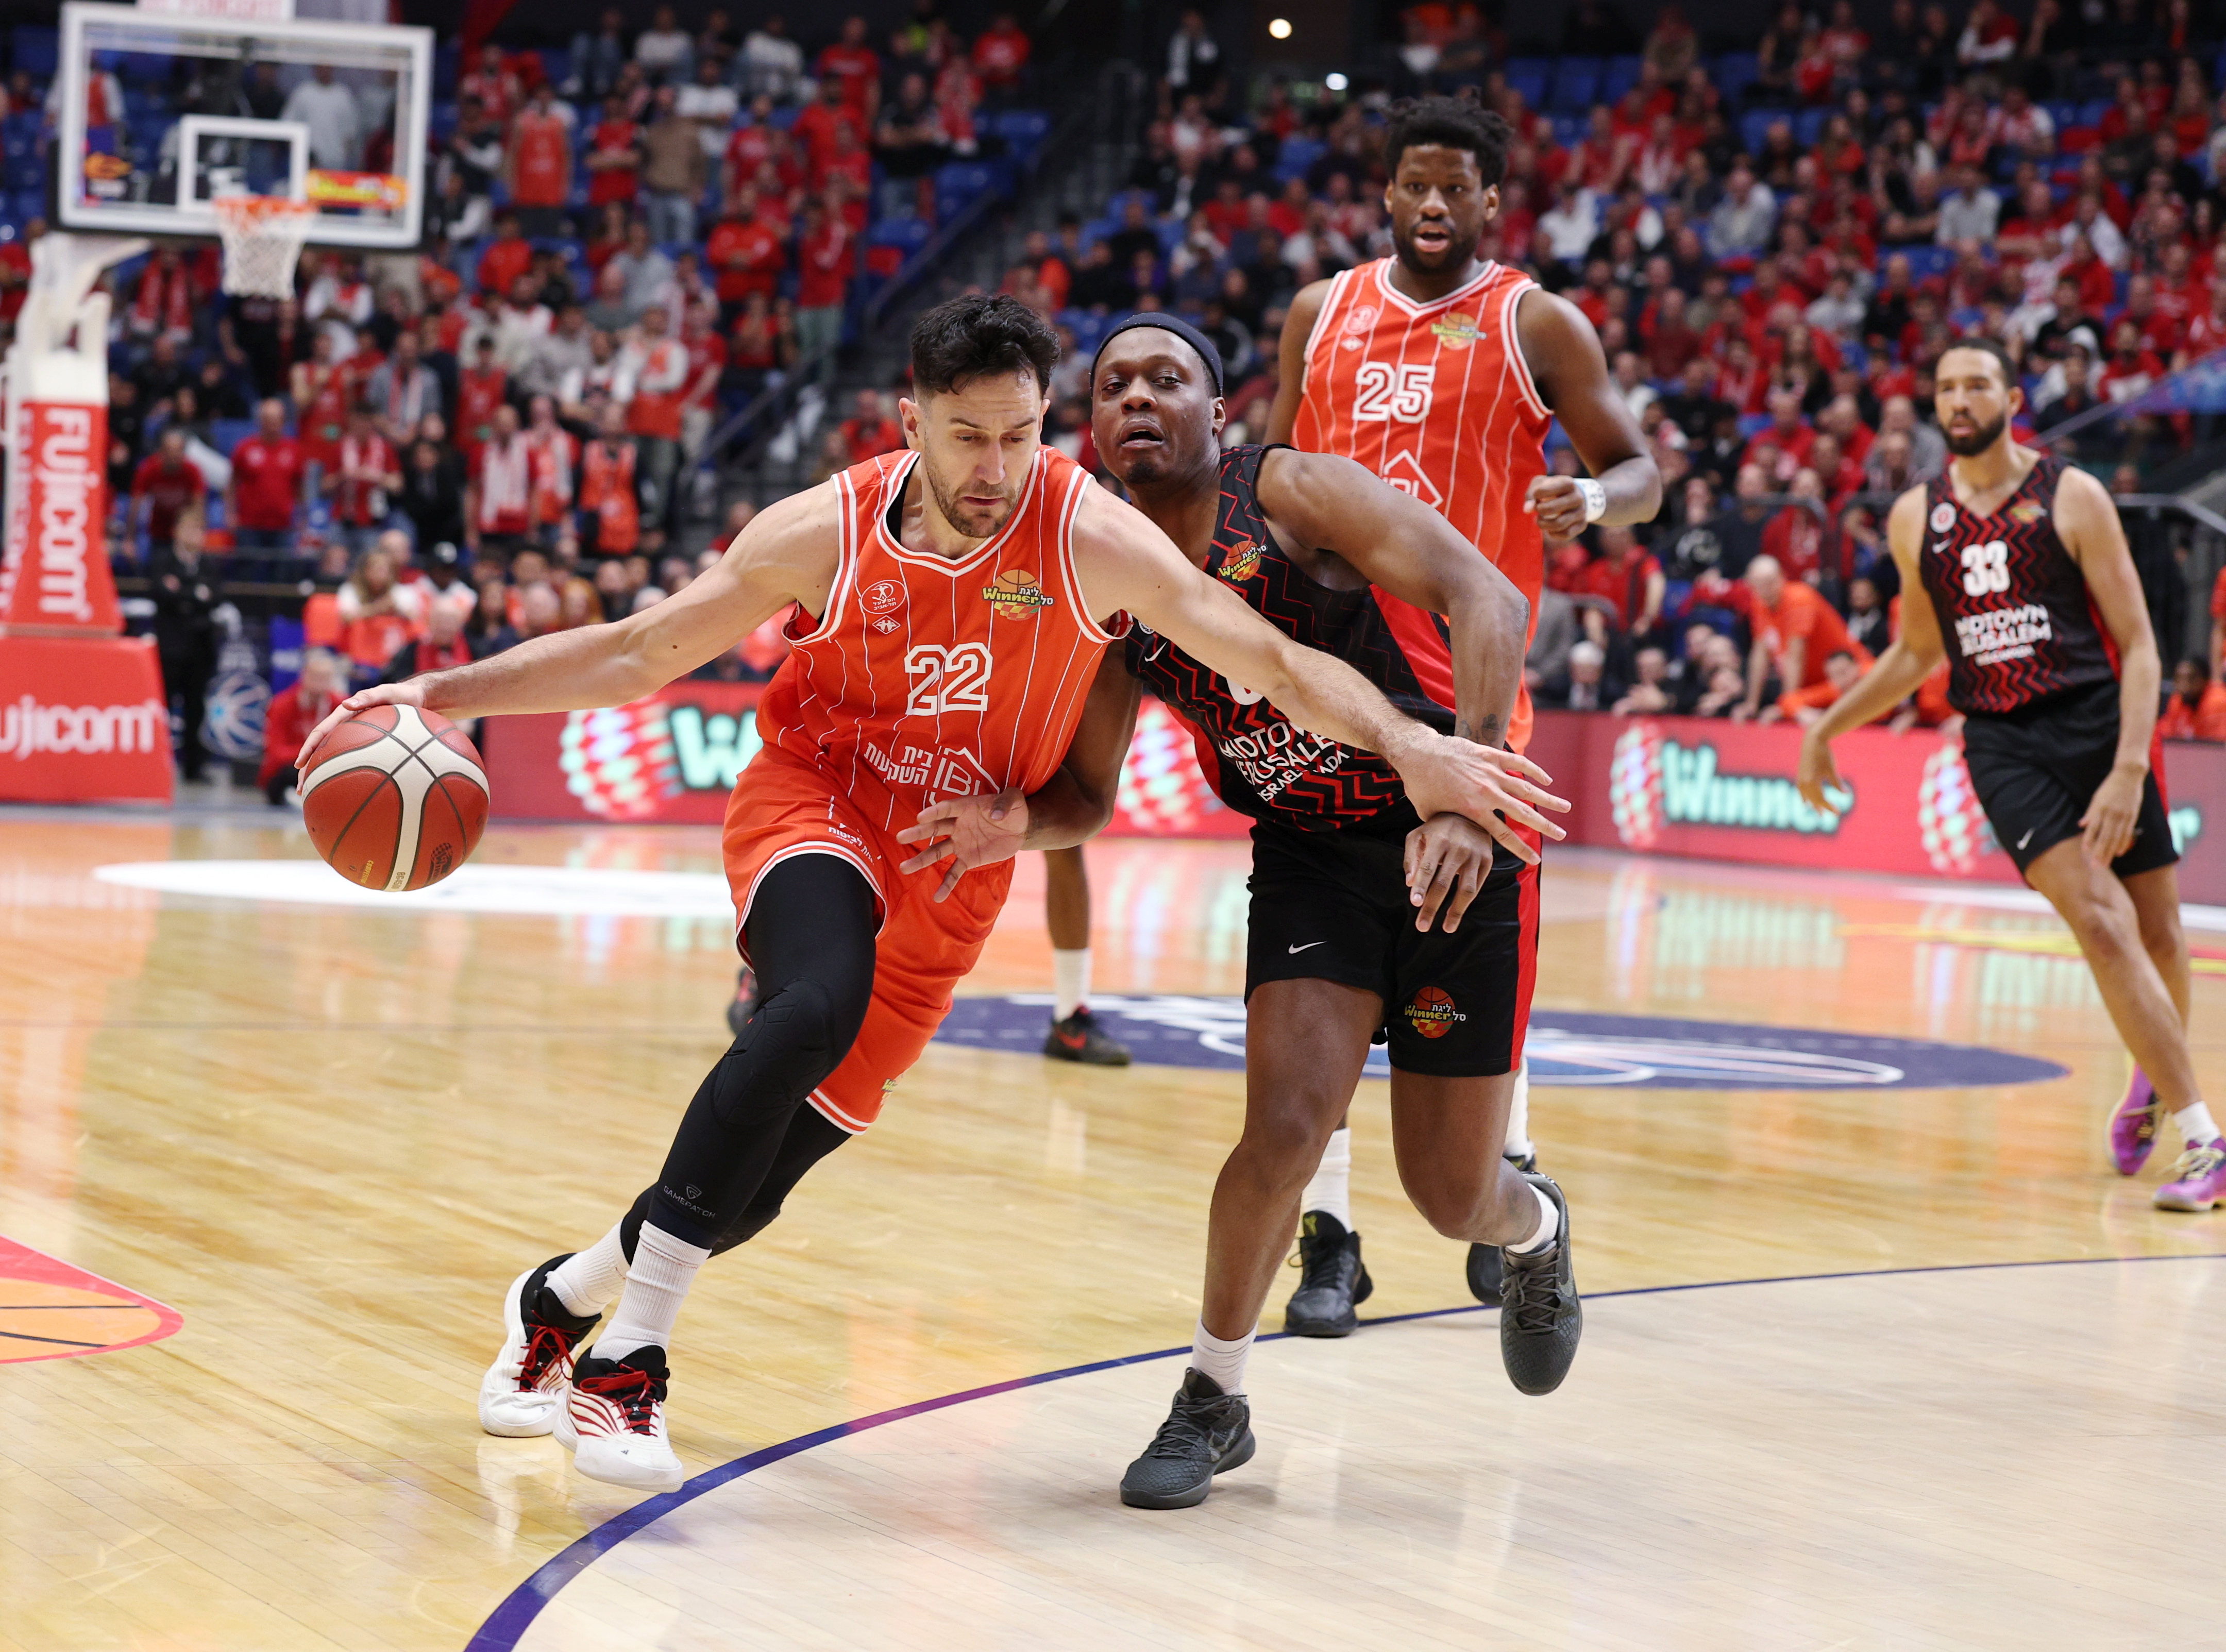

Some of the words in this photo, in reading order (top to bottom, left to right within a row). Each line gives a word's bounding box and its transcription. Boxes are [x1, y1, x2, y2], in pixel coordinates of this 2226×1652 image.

[1352, 361, 1436, 424] 25
[1218, 551, 1258, 577] Winner
[1242, 547, 1256, 559] ליגת
[1961, 540, 2010, 597] 33
[983, 587, 1039, 603] Winner
[1019, 586, 1039, 596] ליגת
[1040, 595, 1053, 605] סל
[905, 642, 993, 716] 22
[1219, 721, 1304, 759] MIDTO
[864, 741, 929, 786] השקעות
[901, 746, 934, 768] בית
[1235, 733, 1336, 786] ERUSALE
[1257, 769, 1303, 802] ISRAEL
[1404, 1004, 1451, 1020] Winner
[1431, 1003, 1452, 1013] ליגת
[1453, 1010, 1466, 1021] סל
[663, 1185, 716, 1219] GAMEPATCH
